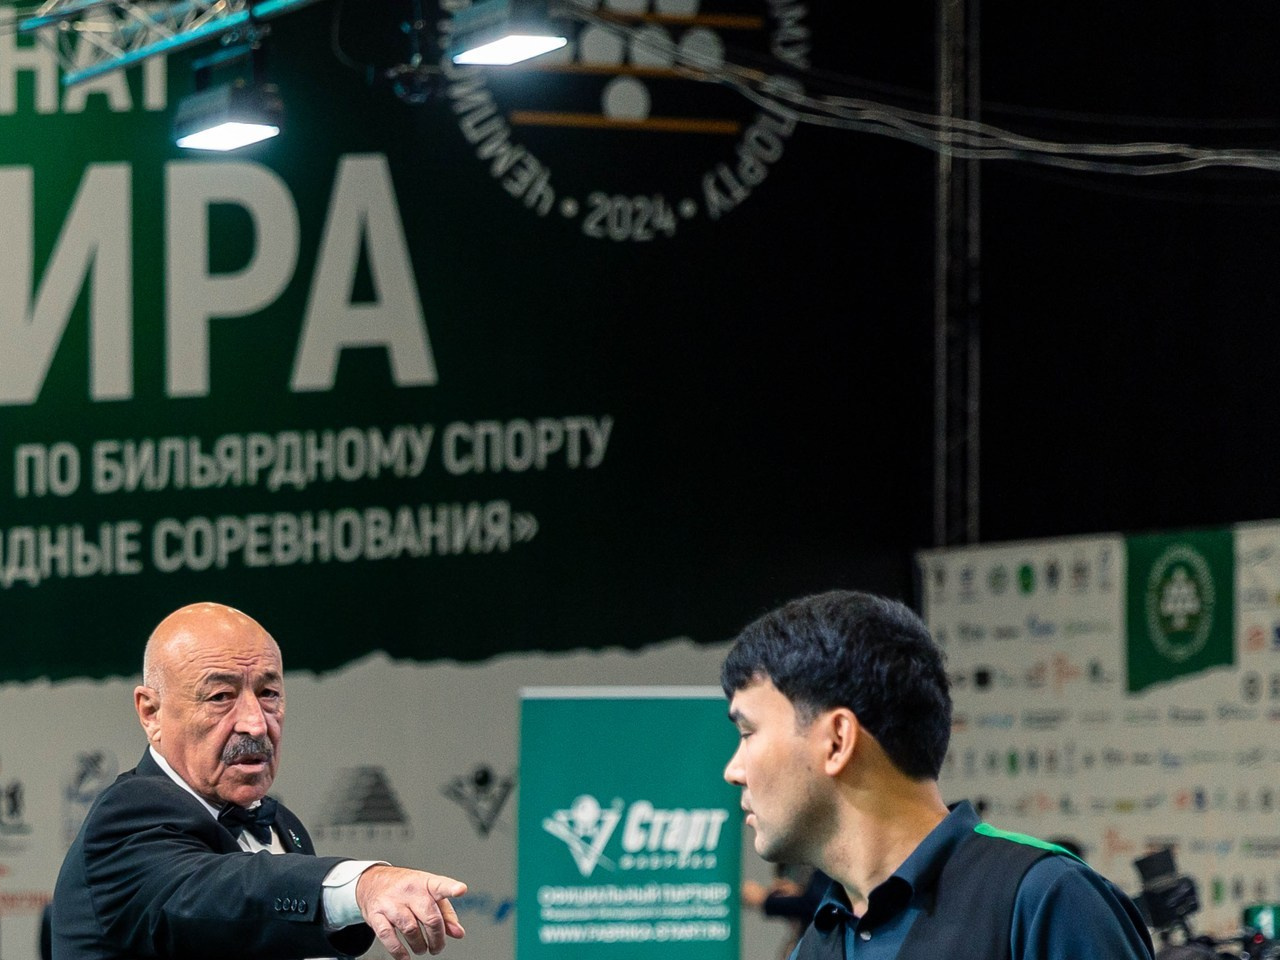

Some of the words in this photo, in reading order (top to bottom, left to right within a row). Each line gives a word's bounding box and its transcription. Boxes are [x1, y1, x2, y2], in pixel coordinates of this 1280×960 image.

[582, 191, 677, 241] 2024
[14, 444, 81, 498] ПО
[92, 425, 434, 494] БИЛЬЯРДНОМУ
[441, 416, 614, 478] СПОРТУ
[152, 500, 539, 572] СОРЕВНОВАНИЯ»
